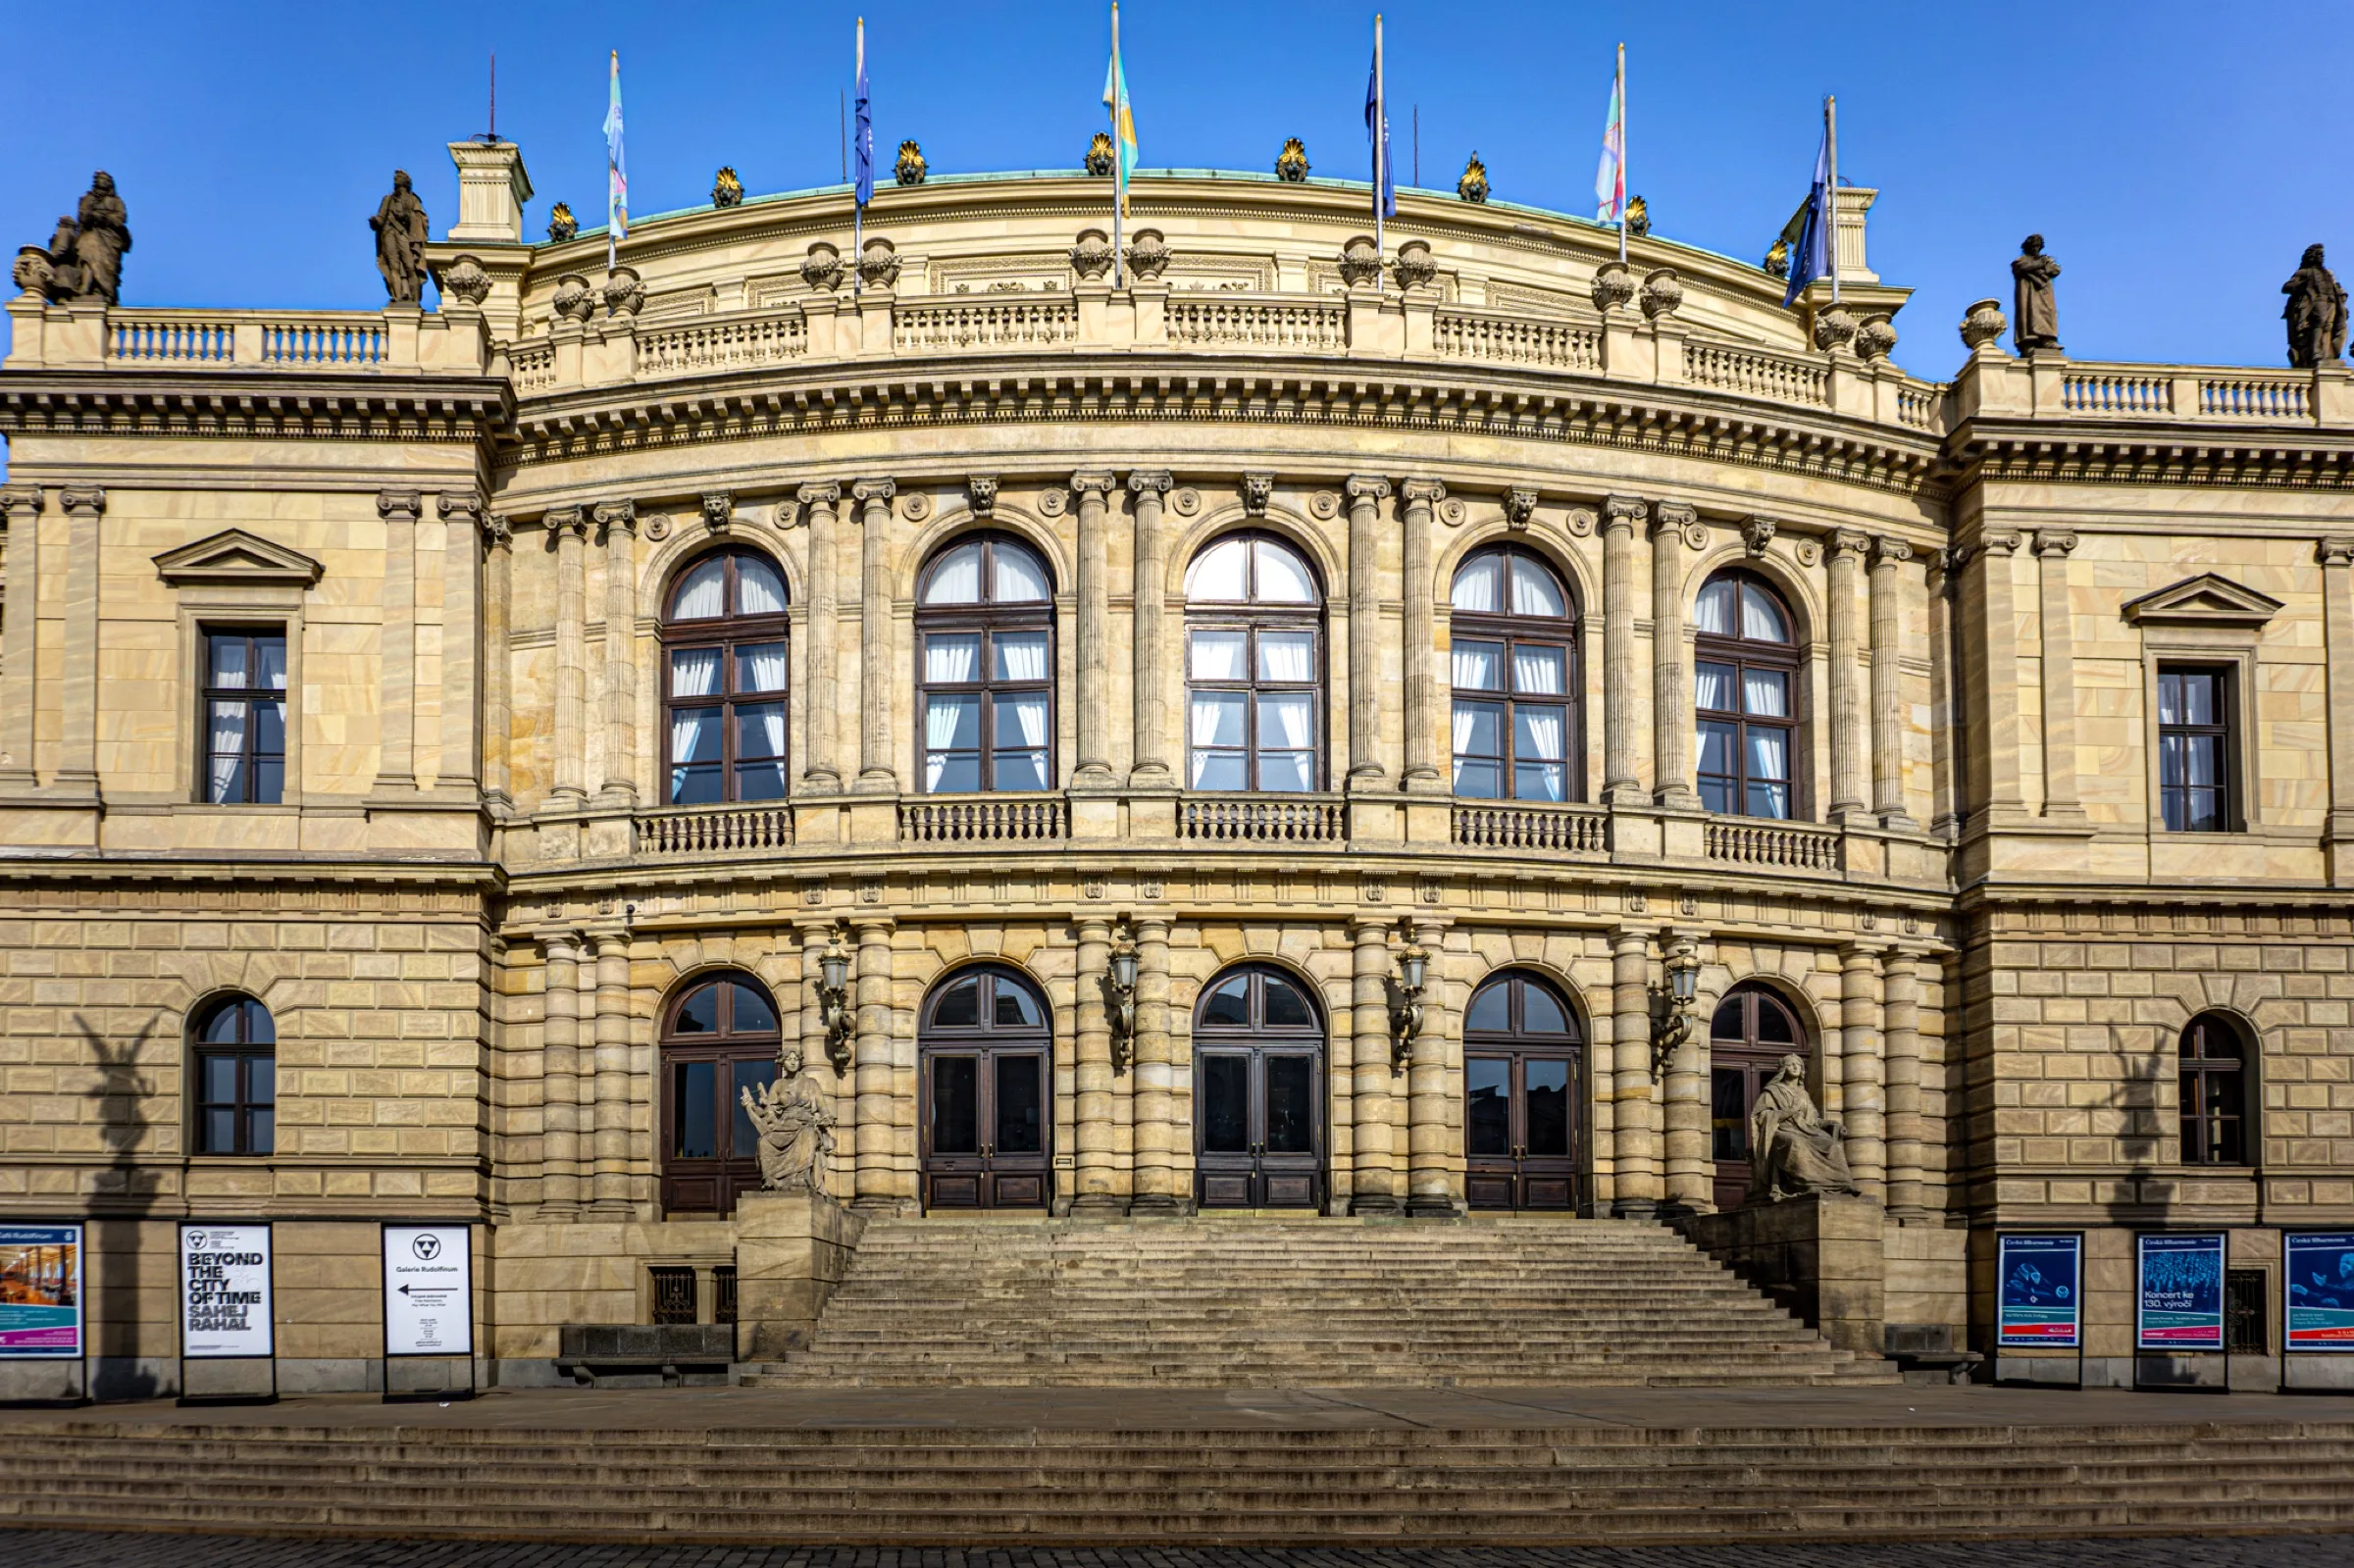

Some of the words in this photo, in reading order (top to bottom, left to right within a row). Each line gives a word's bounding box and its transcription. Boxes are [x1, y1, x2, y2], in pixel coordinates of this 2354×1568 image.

[187, 1252, 263, 1266] BEYOND
[187, 1266, 223, 1279] THE
[187, 1279, 230, 1291] CITY
[188, 1291, 213, 1305] OF
[215, 1291, 261, 1305] TIME
[2145, 1290, 2181, 1299] Koncert
[2182, 1290, 2194, 1299] ke
[2164, 1299, 2193, 1309] výročí
[188, 1305, 248, 1318] SAHEJ
[188, 1318, 251, 1332] RAHAL
